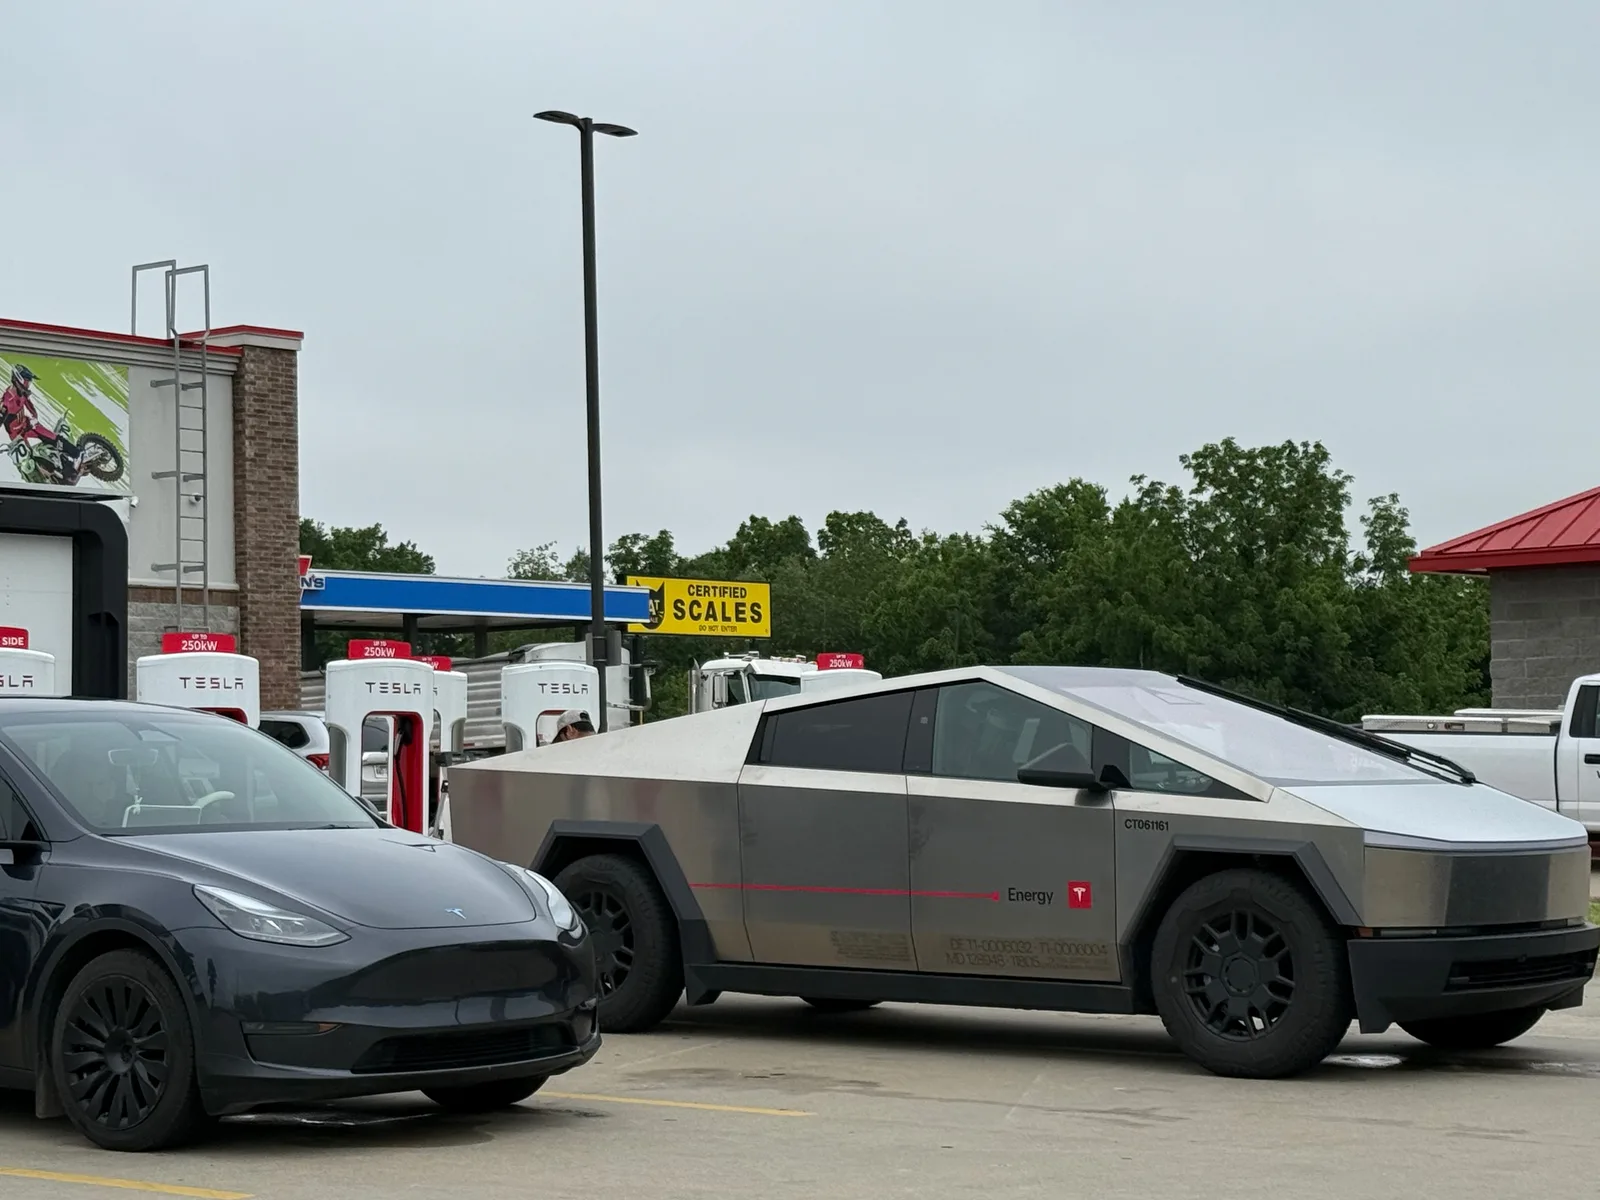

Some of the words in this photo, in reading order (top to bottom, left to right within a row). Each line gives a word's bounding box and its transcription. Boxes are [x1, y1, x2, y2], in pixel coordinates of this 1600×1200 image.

[687, 584, 747, 598] CERTIFIED
[649, 599, 660, 616] AT
[672, 599, 763, 623] SCALES
[2, 637, 24, 646] SIDE
[181, 640, 218, 651] 250kW
[364, 647, 396, 657] 250kW
[829, 659, 853, 668] 250kW
[179, 677, 244, 690] TESLA
[365, 682, 422, 695] TESLA
[538, 683, 589, 694] TESLA
[1124, 818, 1169, 831] CT061161
[1008, 887, 1053, 904] Energy
